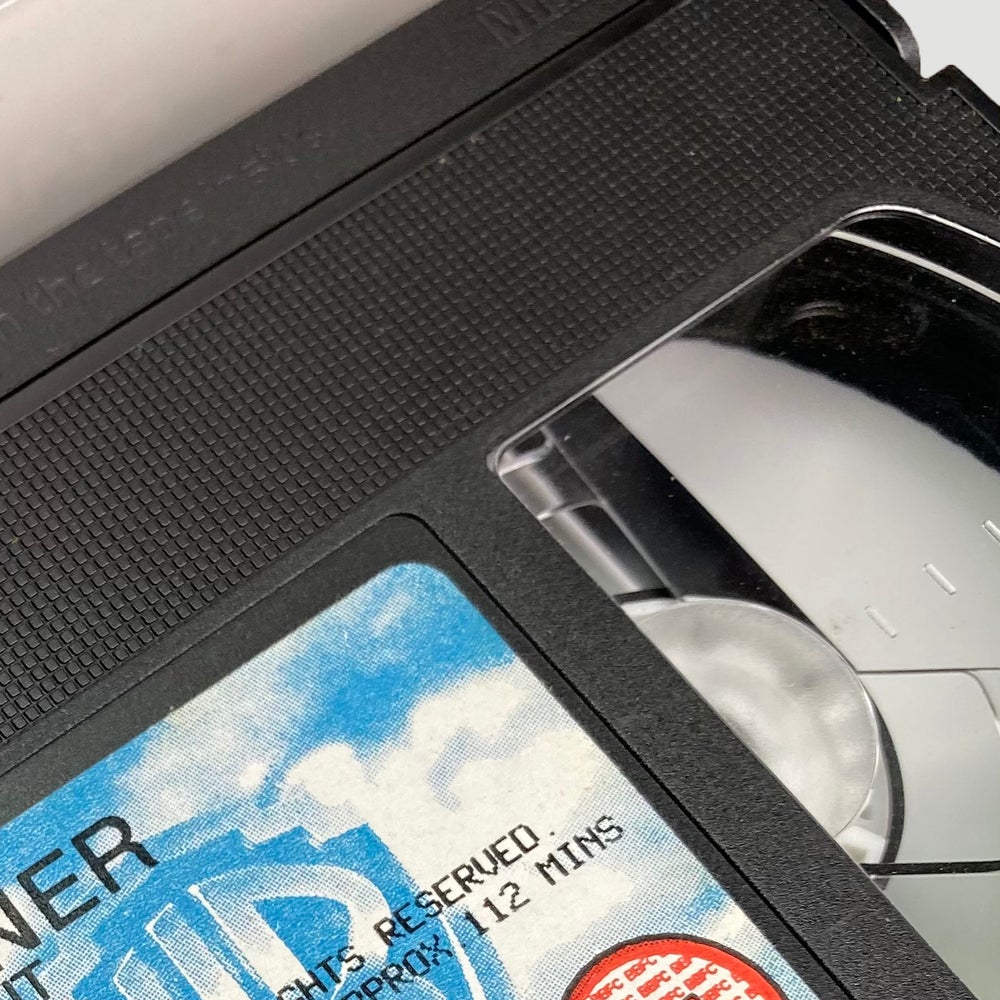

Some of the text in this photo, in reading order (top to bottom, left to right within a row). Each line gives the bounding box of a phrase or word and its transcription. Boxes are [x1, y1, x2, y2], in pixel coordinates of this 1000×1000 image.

[18, 248, 107, 322] the
[372, 823, 555, 948] RESERVED.
[533, 813, 624, 886] MINS
